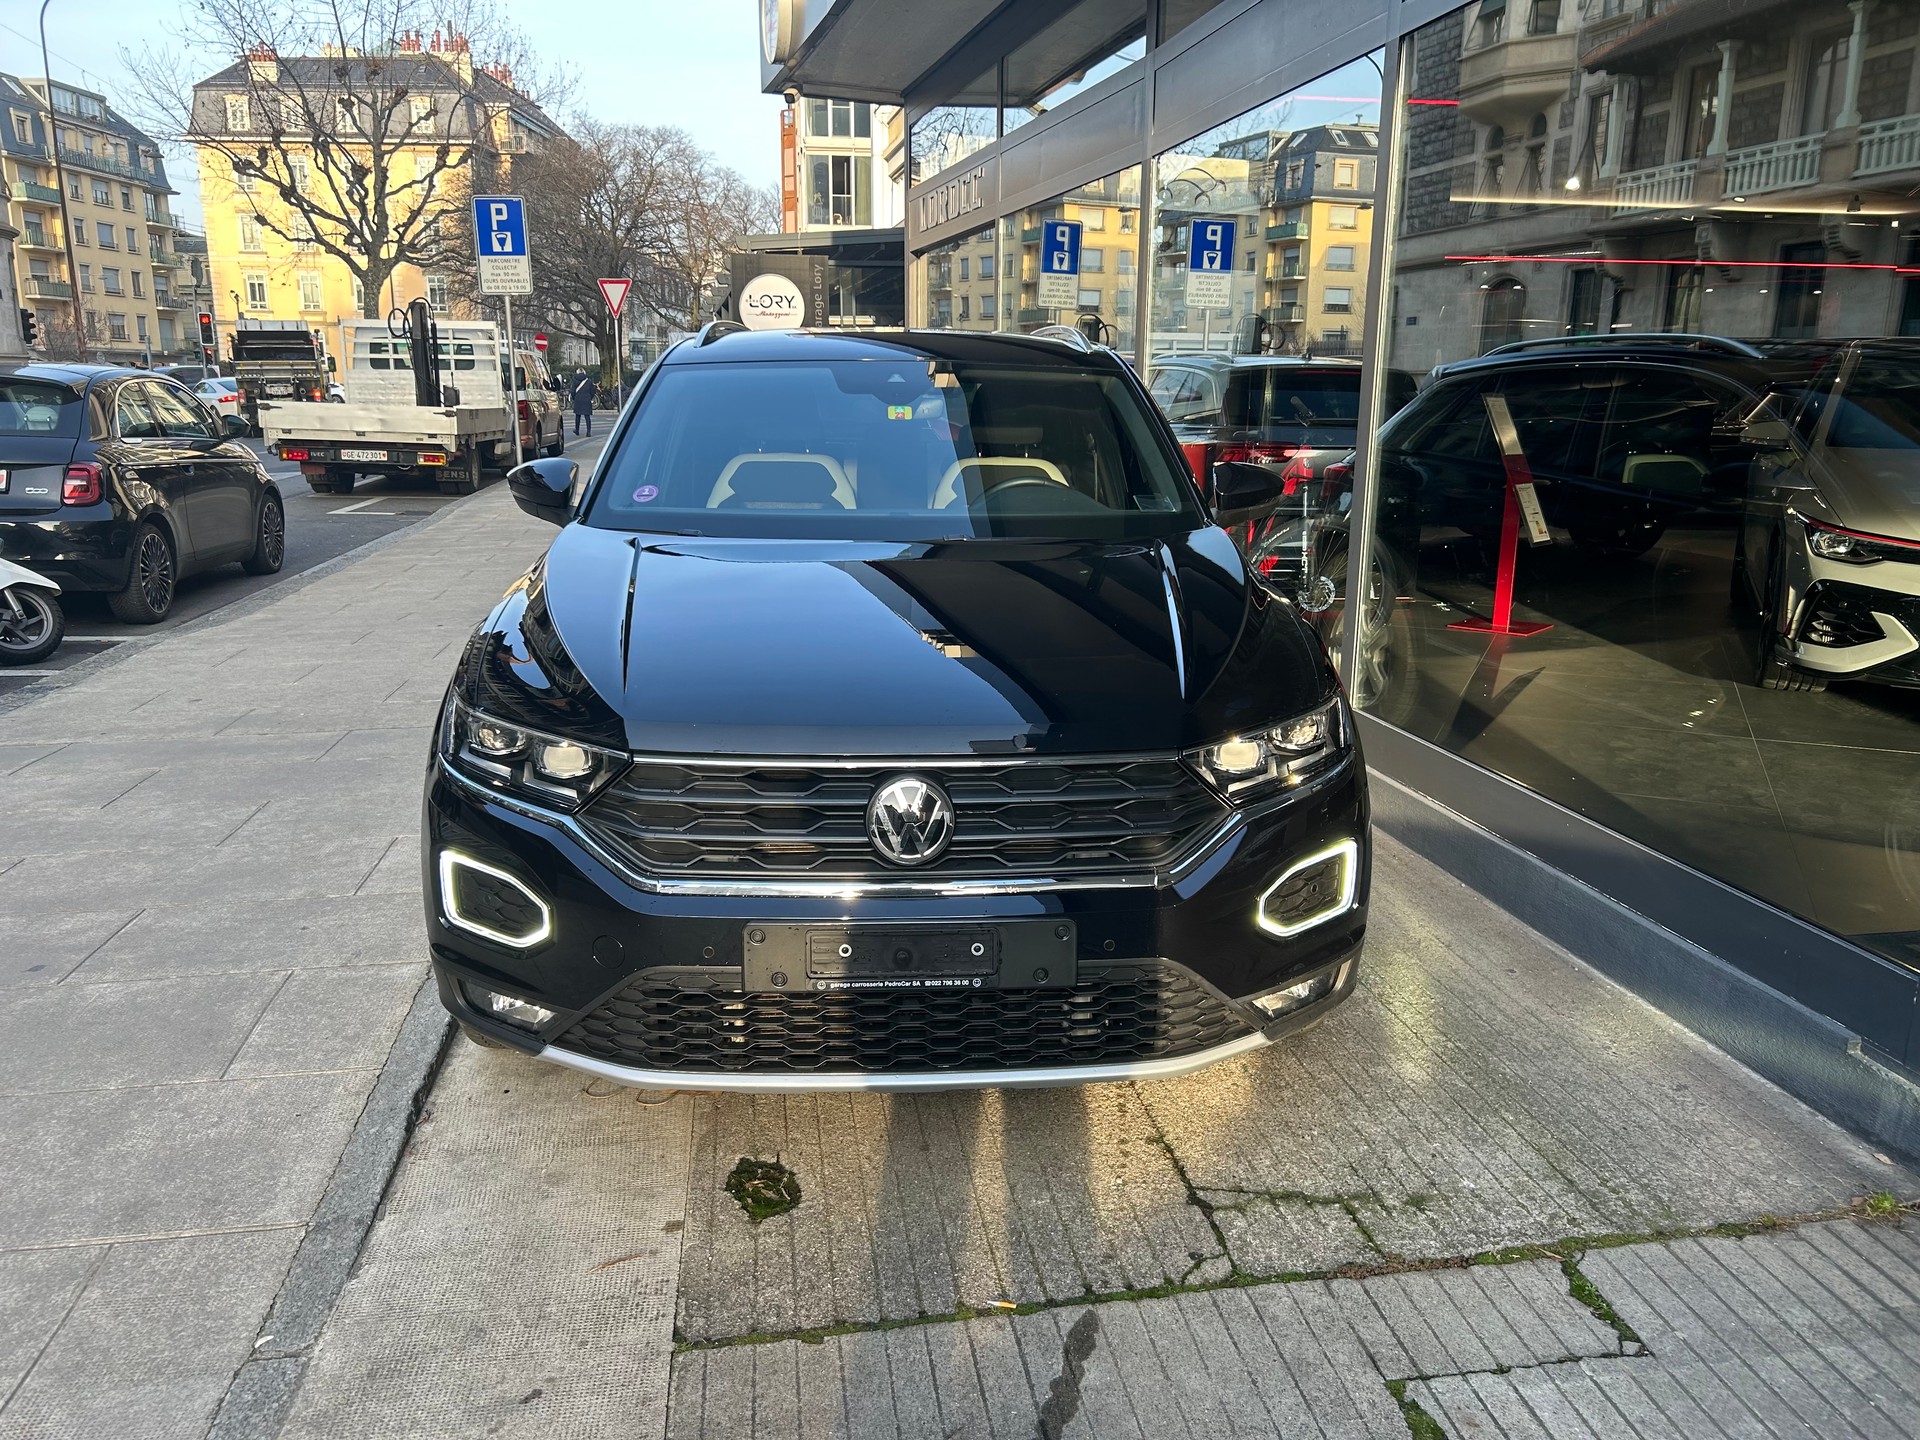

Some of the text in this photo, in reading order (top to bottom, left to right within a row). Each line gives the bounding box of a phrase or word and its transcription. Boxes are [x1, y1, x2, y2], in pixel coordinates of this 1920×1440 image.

[489, 202, 508, 231] P
[749, 294, 795, 309] LORY
[813, 264, 825, 327] arage Lory
[346, 451, 382, 459] GE 472301
[436, 470, 470, 480] SENSI
